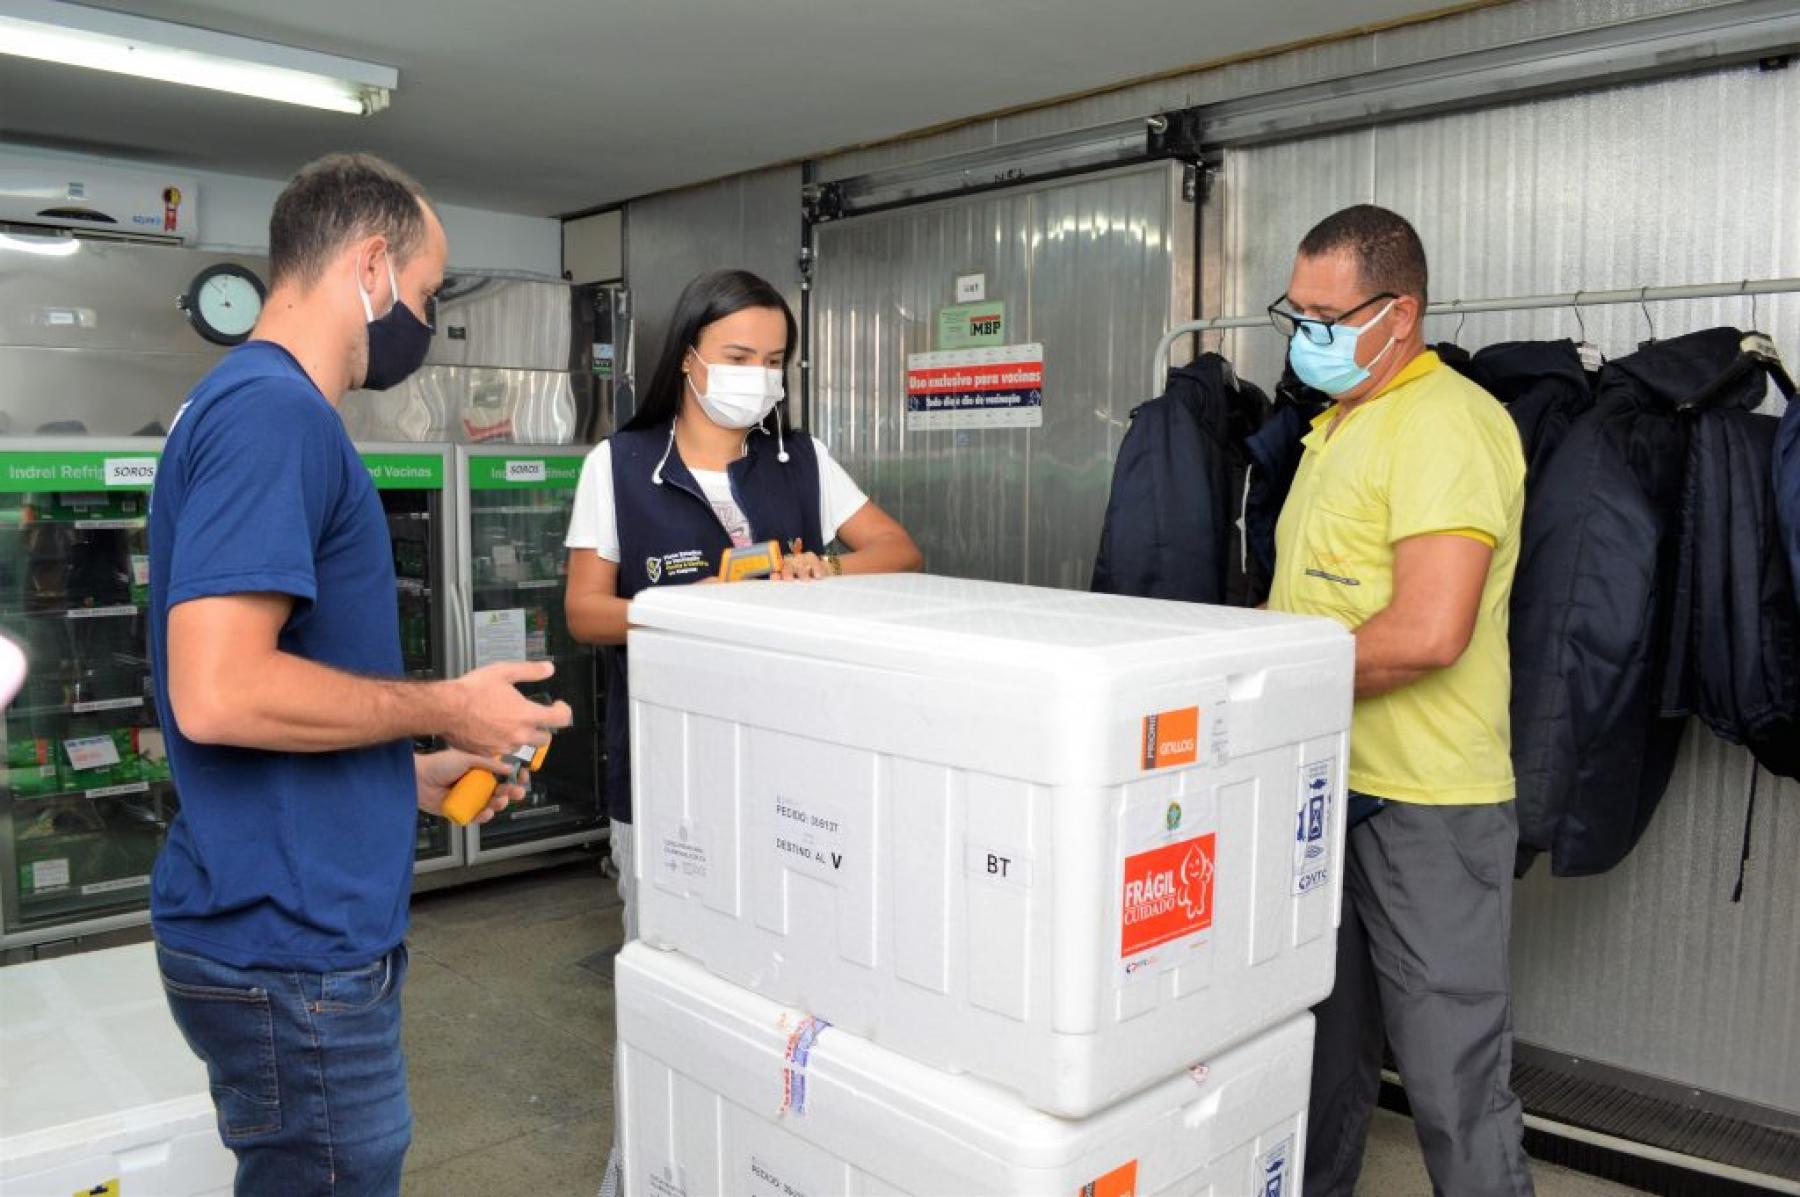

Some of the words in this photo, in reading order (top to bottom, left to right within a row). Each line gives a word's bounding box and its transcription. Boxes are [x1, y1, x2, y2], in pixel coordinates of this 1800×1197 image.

[909, 375, 927, 389] Uso
[928, 371, 973, 388] exclusivo
[974, 373, 1000, 388] para
[1001, 368, 1041, 385] vacinas
[9, 464, 55, 480] Indrel
[113, 466, 154, 478] SOROS
[384, 465, 432, 478] Vacinas
[509, 465, 540, 475] SOROS
[987, 853, 1012, 878] BT
[1125, 869, 1176, 907] FRÁGIL
[1124, 896, 1175, 925] CUIDADO
